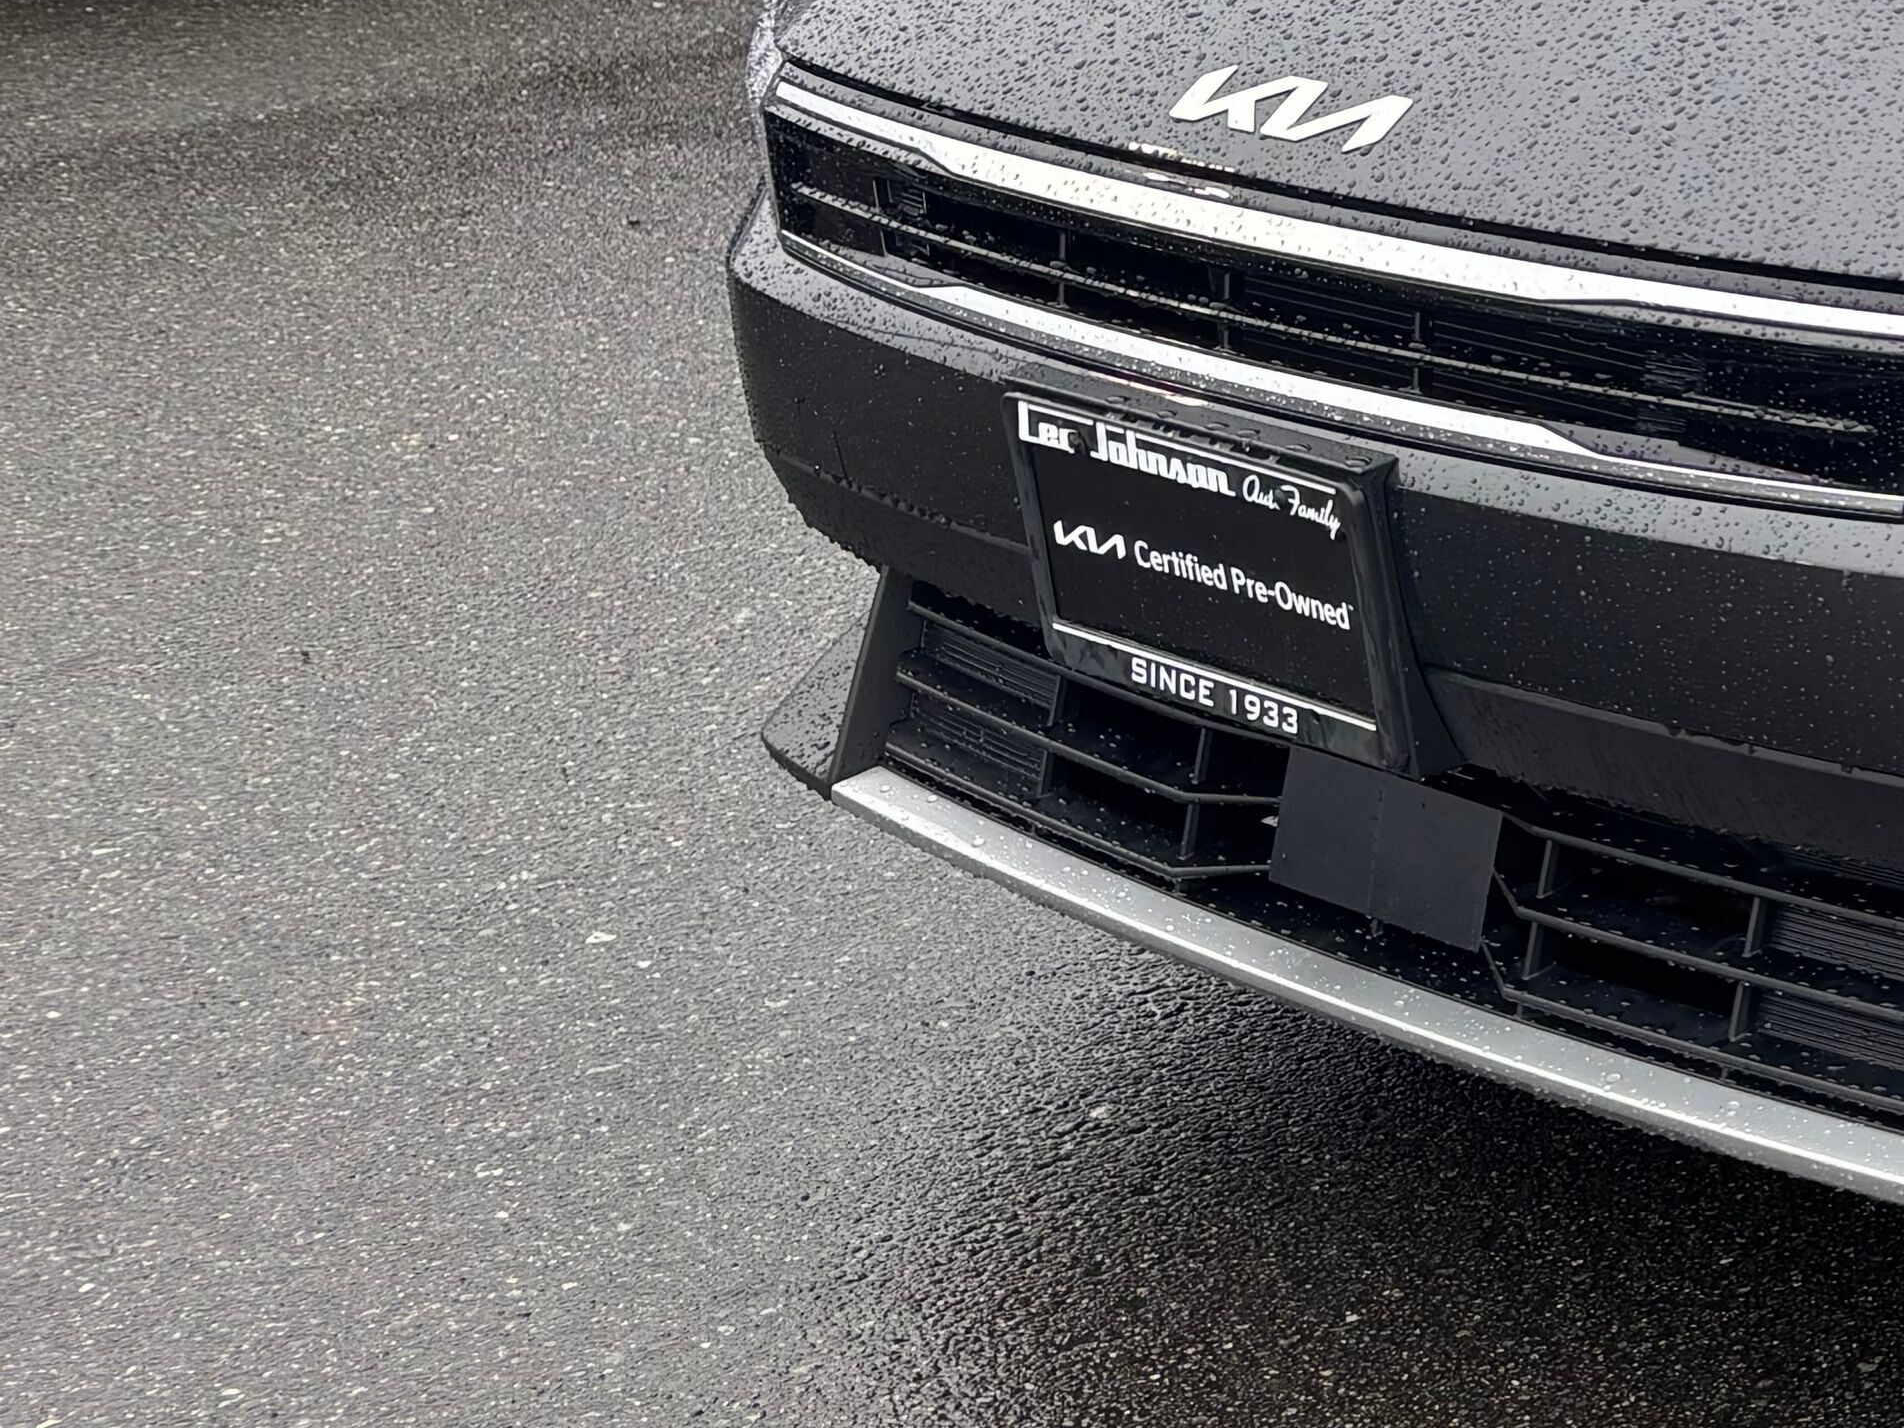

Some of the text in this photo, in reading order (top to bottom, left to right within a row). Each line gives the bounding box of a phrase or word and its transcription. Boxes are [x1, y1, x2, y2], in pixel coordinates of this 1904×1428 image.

[1169, 65, 1414, 154] KIA
[1089, 422, 1237, 498] Johnson
[1280, 484, 1341, 540] Family
[1053, 519, 1354, 631] KIA Certified Pre-Owned
[1130, 656, 1299, 735] SINCE 1933
